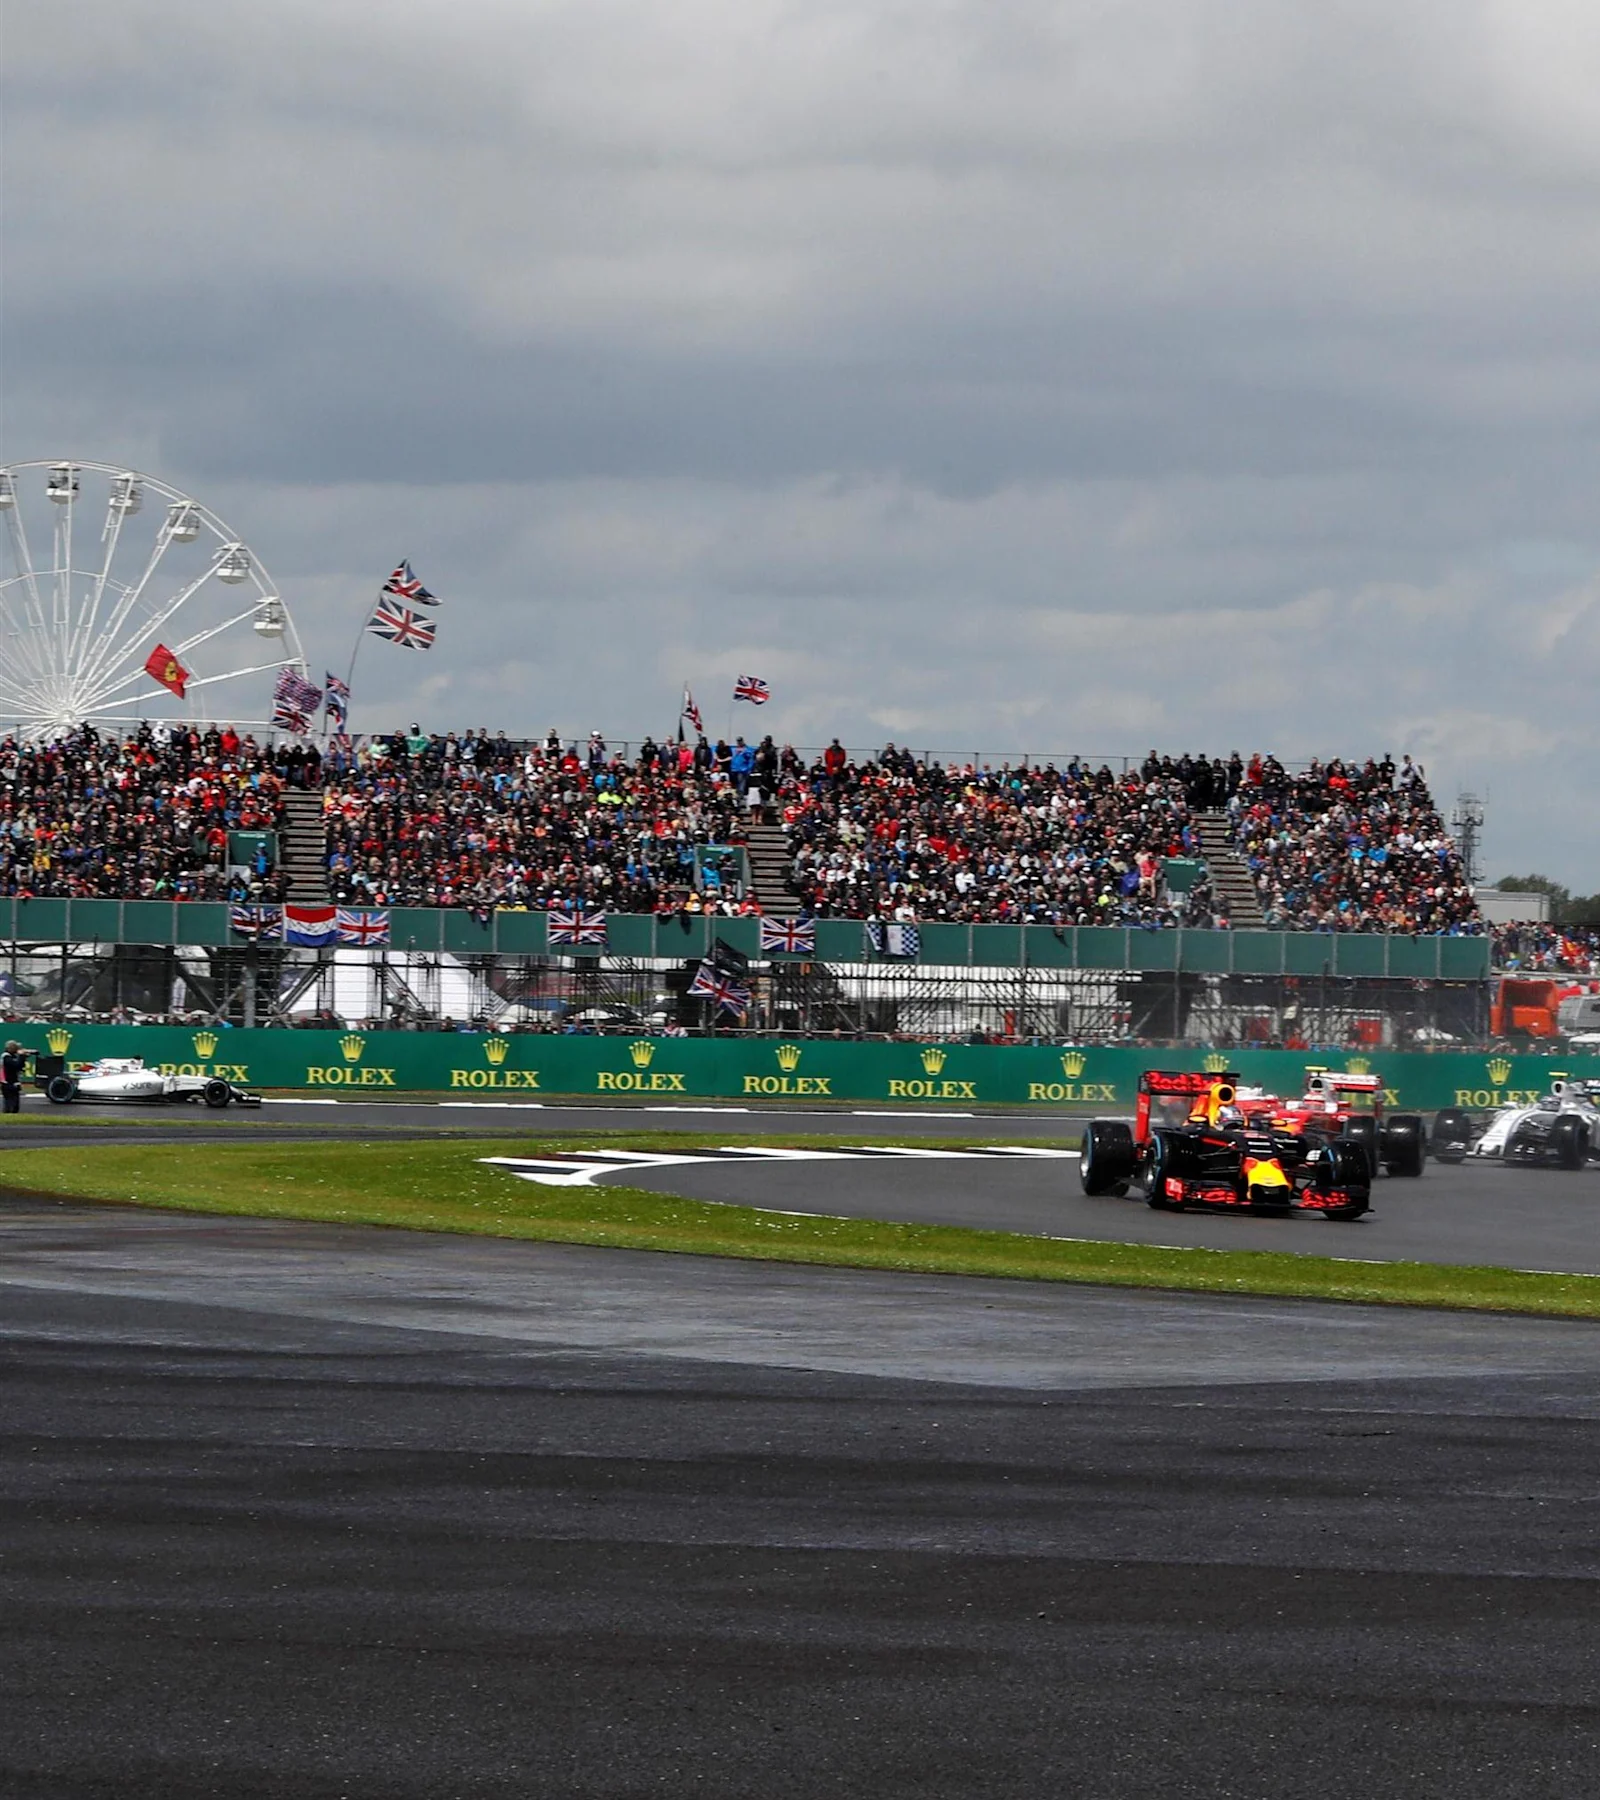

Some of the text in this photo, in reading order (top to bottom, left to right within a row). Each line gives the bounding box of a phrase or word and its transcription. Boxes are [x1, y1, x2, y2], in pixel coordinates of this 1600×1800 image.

[159, 1063, 250, 1083] ROLEX
[306, 1067, 396, 1087] ROLEX
[450, 1070, 539, 1089] ROLEX
[597, 1073, 686, 1092] ROLEX
[743, 1076, 832, 1095] ROLEX
[888, 1080, 977, 1099] ROLEX
[1028, 1083, 1117, 1101] ROLEX
[1455, 1090, 1541, 1107] ROLEX
